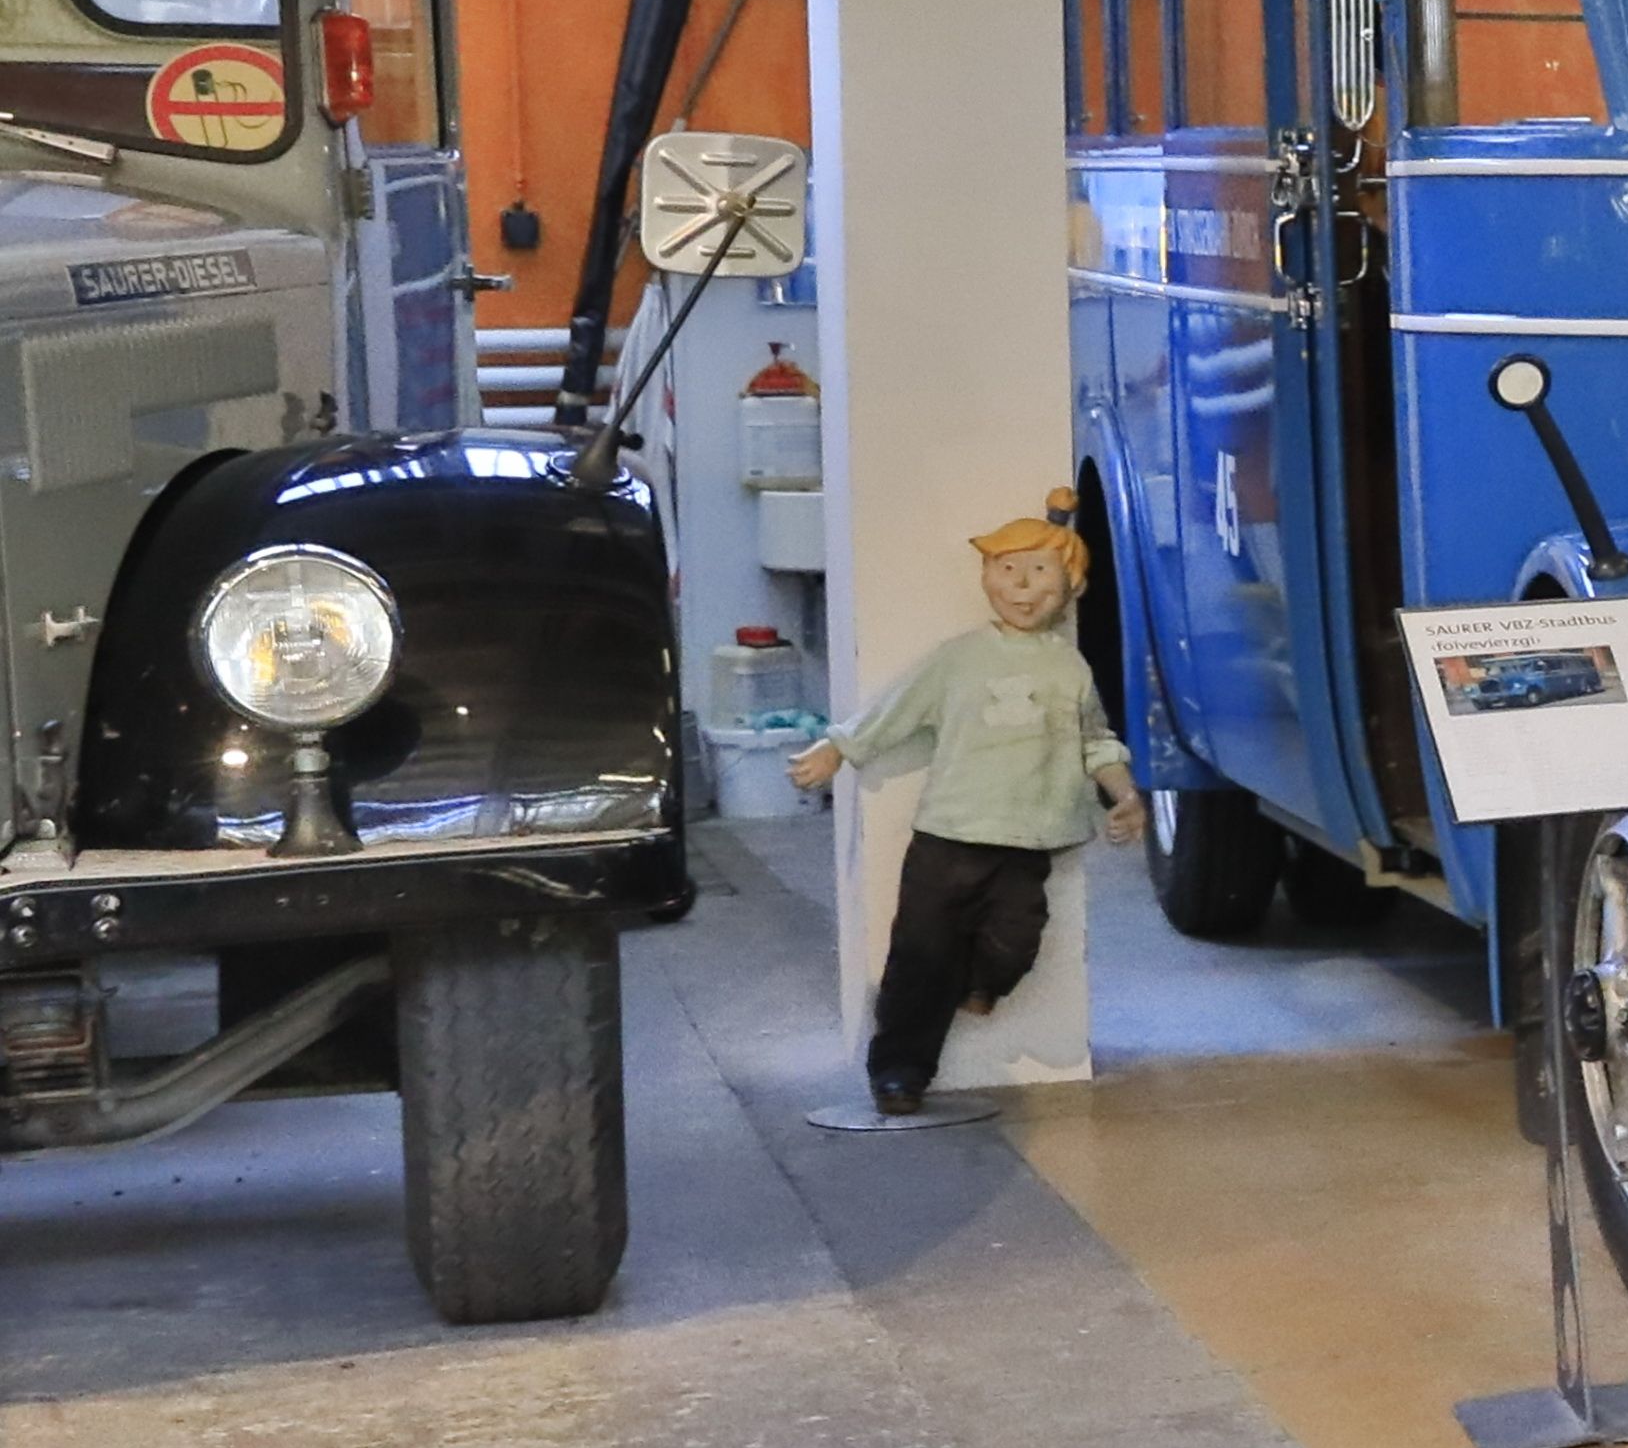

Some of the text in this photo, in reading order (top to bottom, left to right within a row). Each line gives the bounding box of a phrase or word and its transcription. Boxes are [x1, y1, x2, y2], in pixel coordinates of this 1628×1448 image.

[80, 254, 249, 301] SAURER-DIESEL
[1215, 449, 1241, 558] 45
[1425, 621, 1494, 637] SAURER
